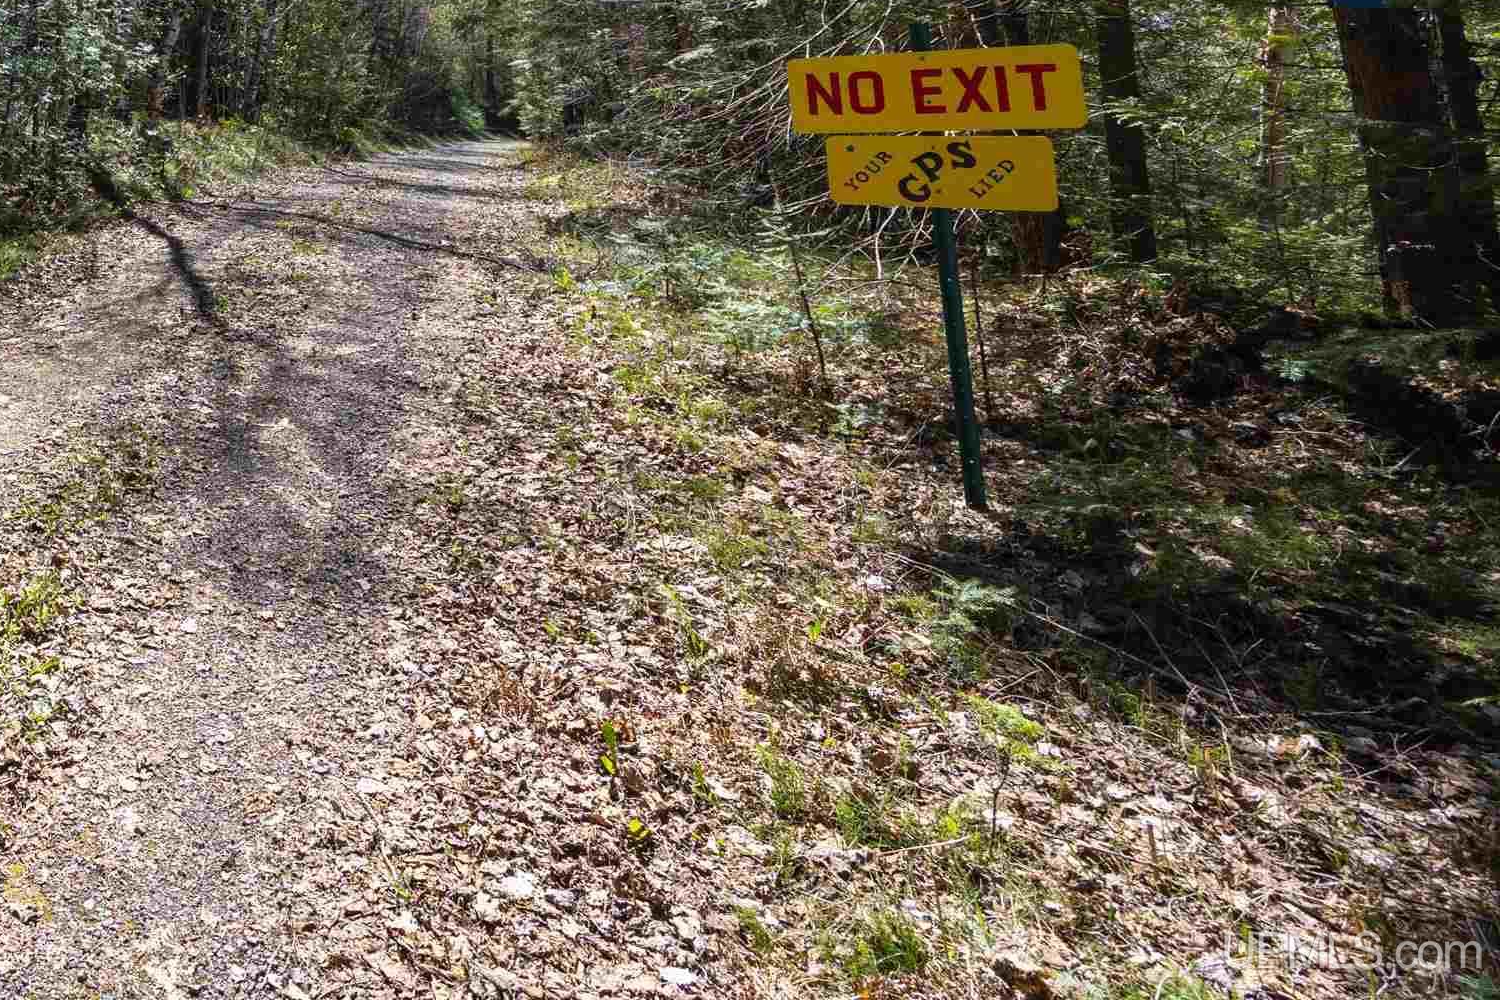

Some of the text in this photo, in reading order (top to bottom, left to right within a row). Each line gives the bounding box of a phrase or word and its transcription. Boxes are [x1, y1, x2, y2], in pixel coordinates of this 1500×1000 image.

[805, 63, 1057, 116] NO EXIT
[843, 139, 1017, 203] YOUR GPS LIED
